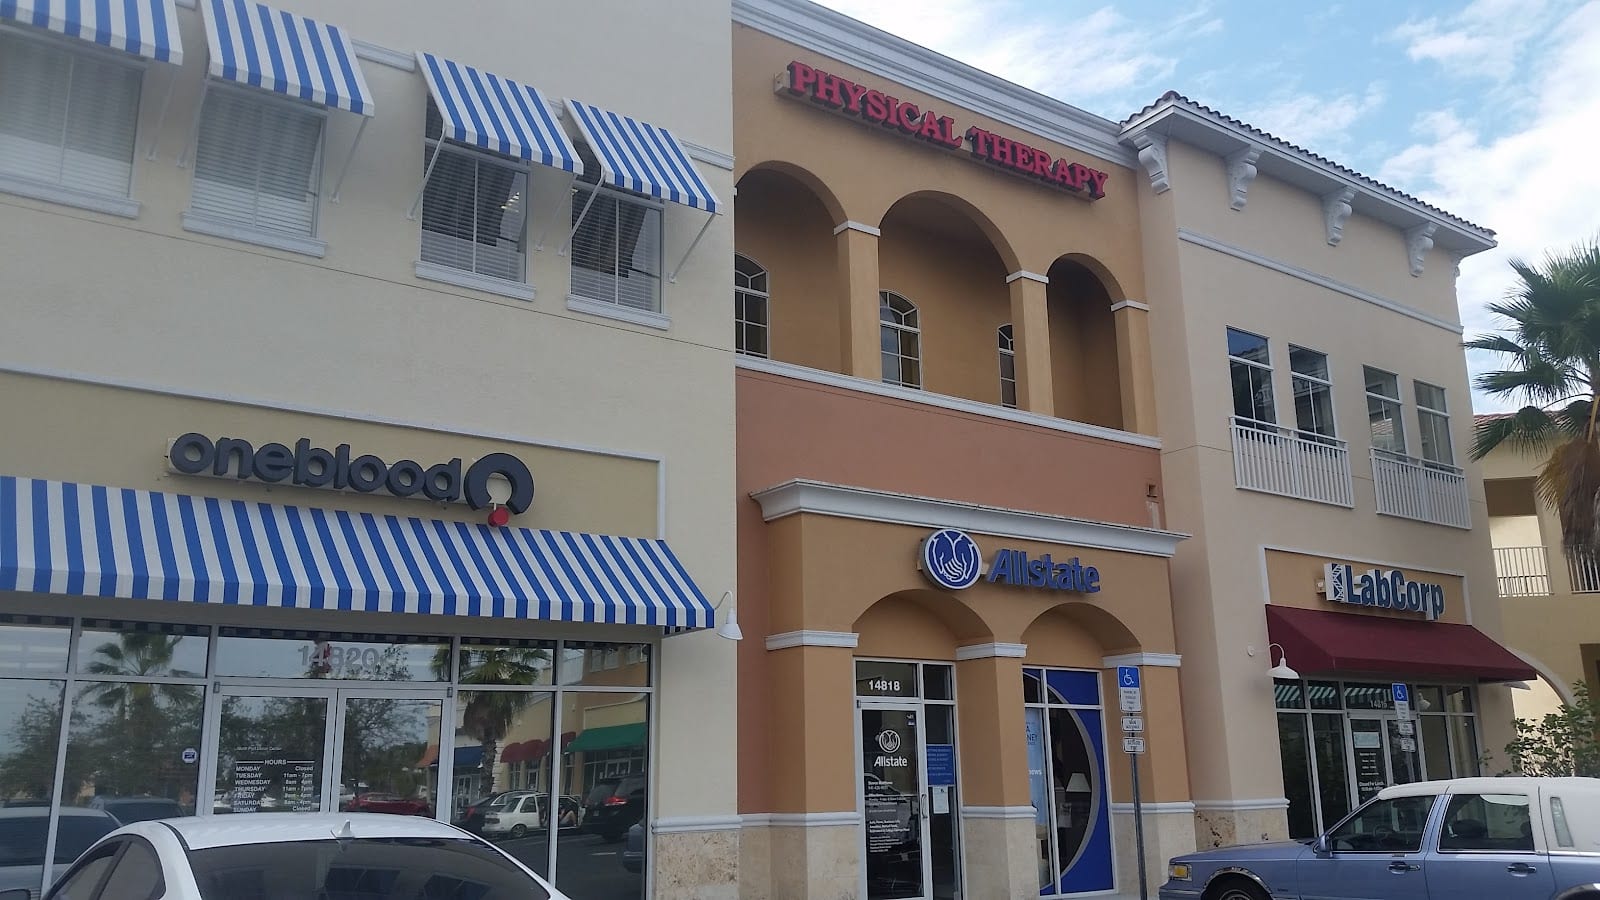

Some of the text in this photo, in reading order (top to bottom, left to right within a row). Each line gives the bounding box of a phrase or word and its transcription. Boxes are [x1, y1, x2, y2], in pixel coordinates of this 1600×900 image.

[789, 61, 1109, 200] PHYSICAL THERAPY
[169, 432, 462, 502] oneblood
[987, 548, 1101, 593] Allstate
[1345, 564, 1445, 621] LabCorp
[868, 680, 901, 691] 14818
[874, 755, 908, 767] Allstate
